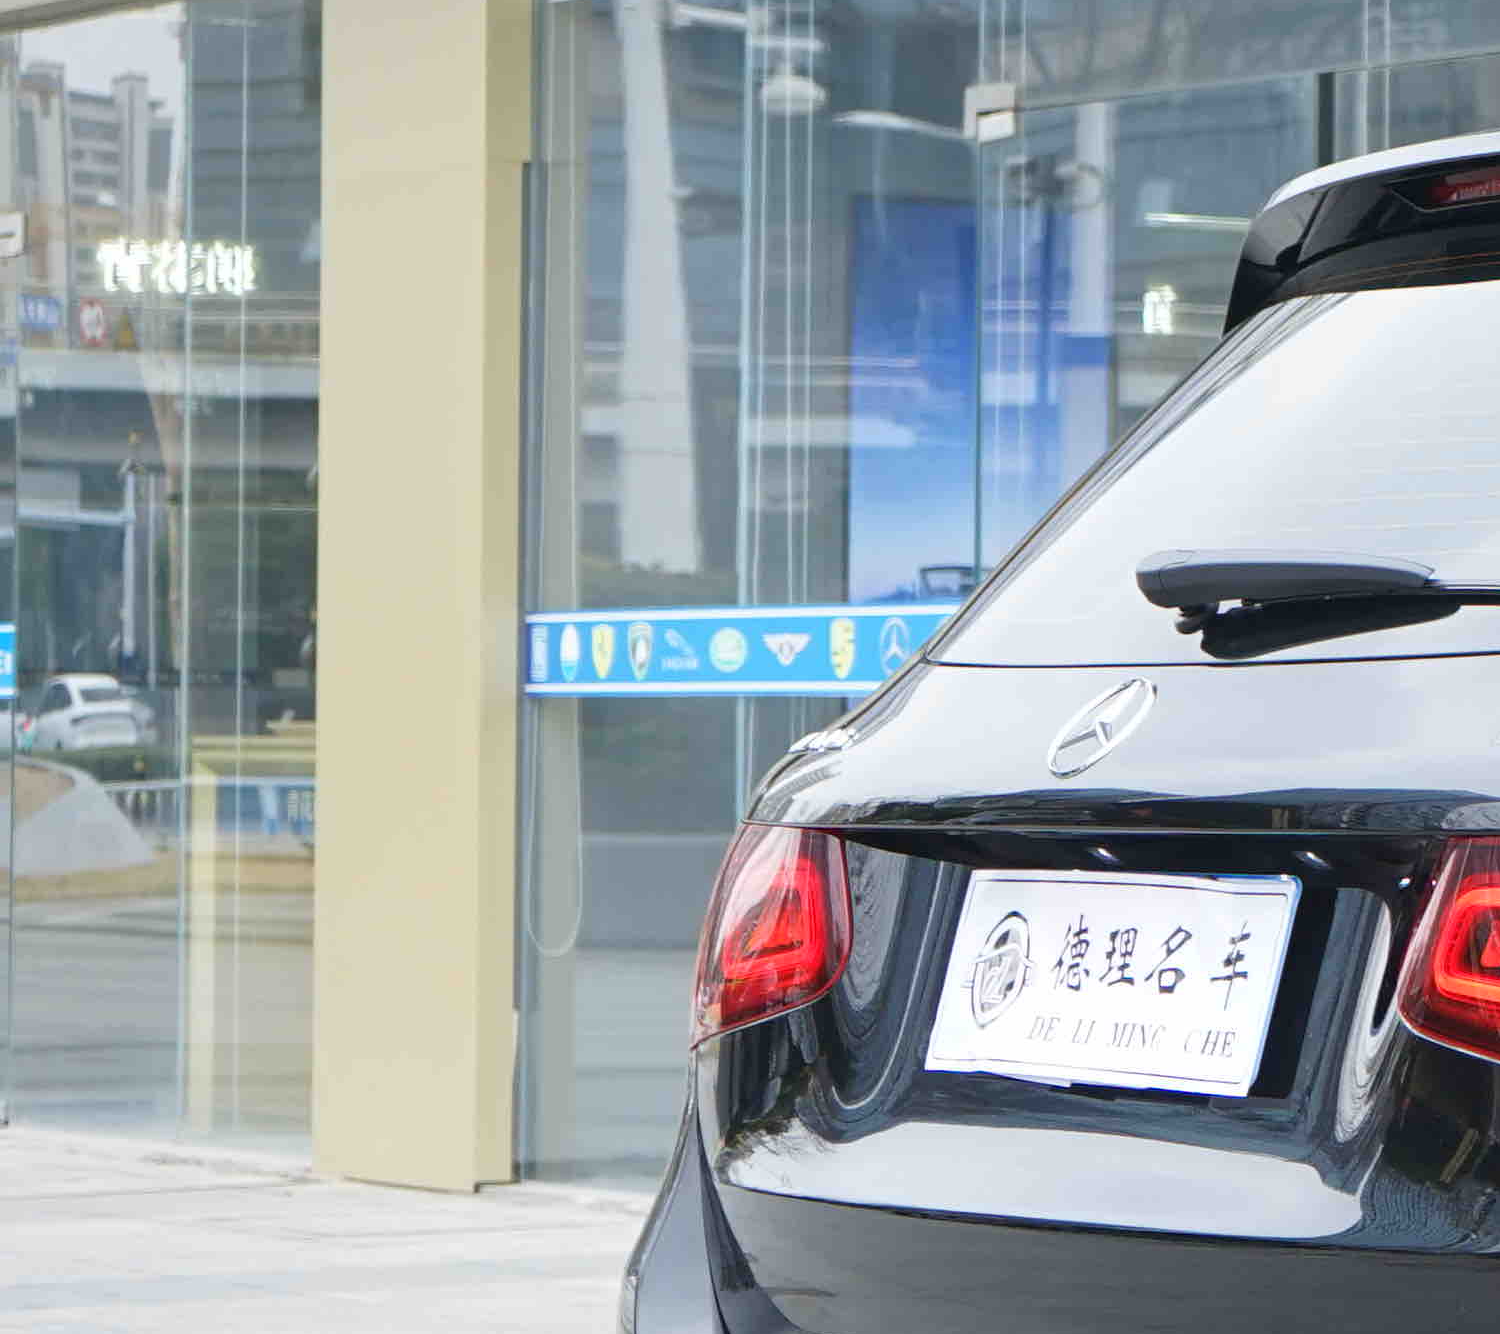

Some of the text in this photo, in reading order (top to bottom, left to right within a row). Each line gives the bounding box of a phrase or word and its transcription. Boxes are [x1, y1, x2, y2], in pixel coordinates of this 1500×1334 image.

[1050, 914, 1252, 1011] 德理名车
[1027, 1015, 1237, 1058] DE LI MING CHE
